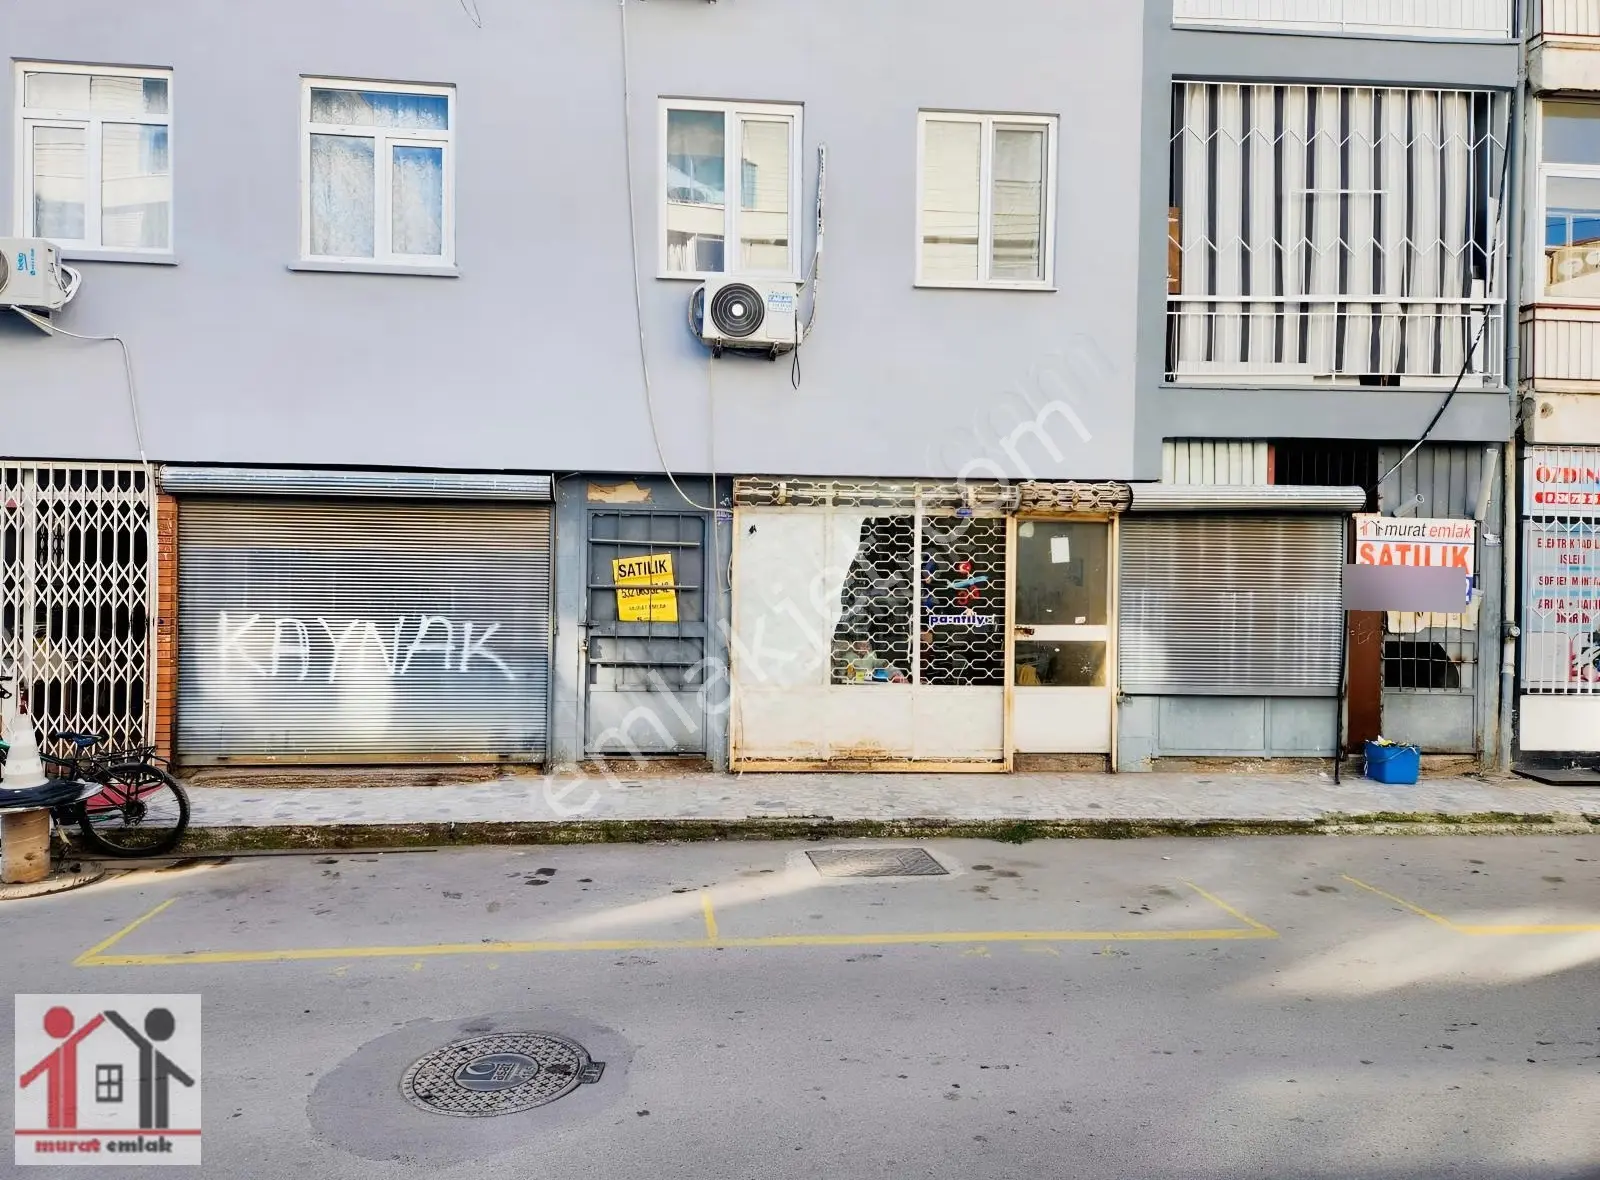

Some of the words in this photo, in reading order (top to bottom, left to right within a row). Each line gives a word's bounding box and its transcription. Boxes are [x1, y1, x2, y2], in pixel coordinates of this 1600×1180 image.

[1384, 522, 1427, 537] murat
[1429, 523, 1472, 539] emlak
[618, 560, 668, 578] SATILIK
[218, 610, 515, 684] KAYNAK
